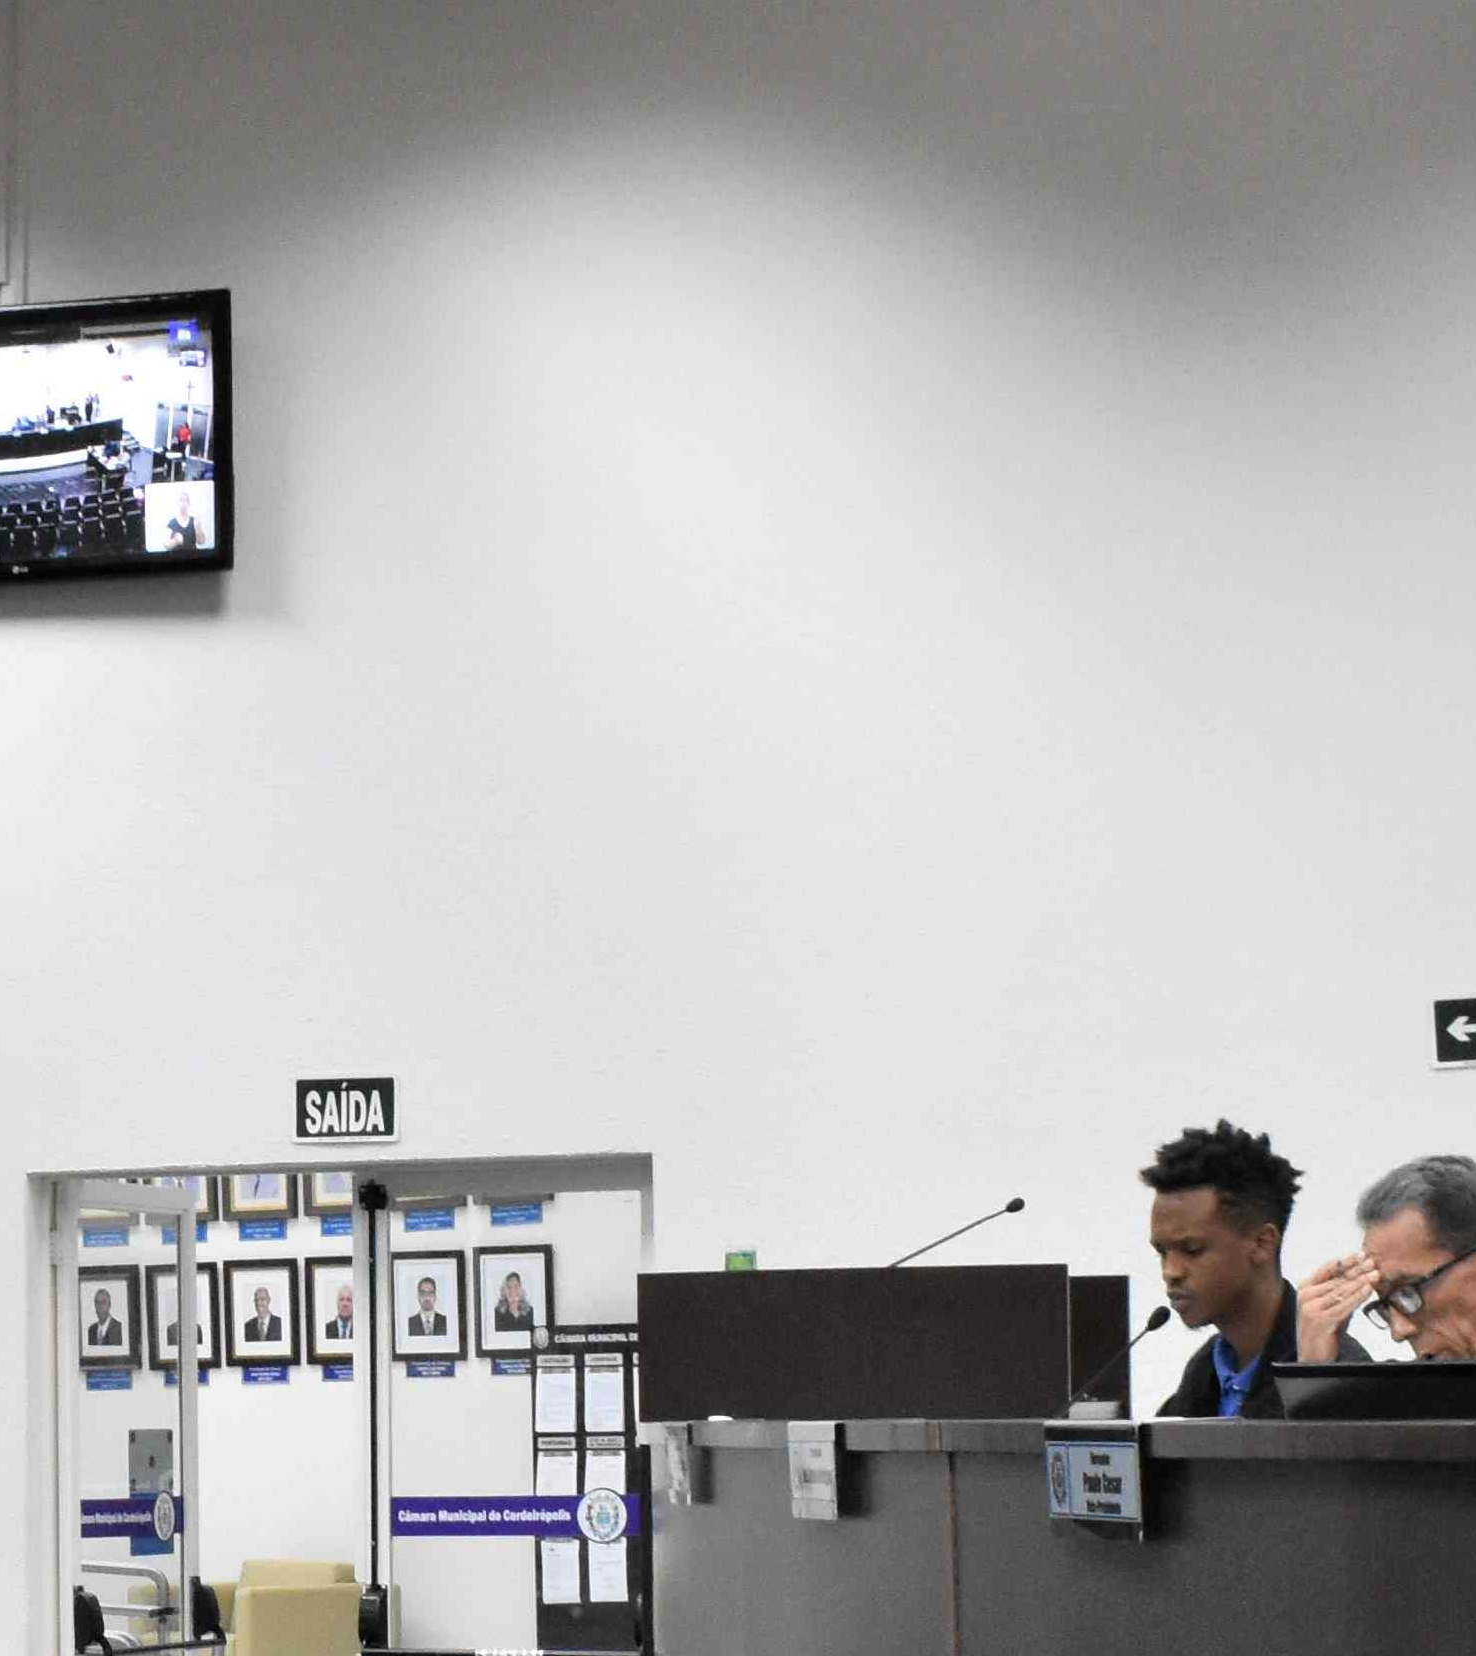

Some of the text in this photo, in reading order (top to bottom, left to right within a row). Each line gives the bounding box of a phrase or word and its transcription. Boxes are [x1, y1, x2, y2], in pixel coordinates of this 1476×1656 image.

[305, 1081, 385, 1135] SAÍDA
[398, 1509, 436, 1523] Câmara
[439, 1509, 486, 1524] Municipal
[503, 1508, 571, 1524] Cordeirópolis
